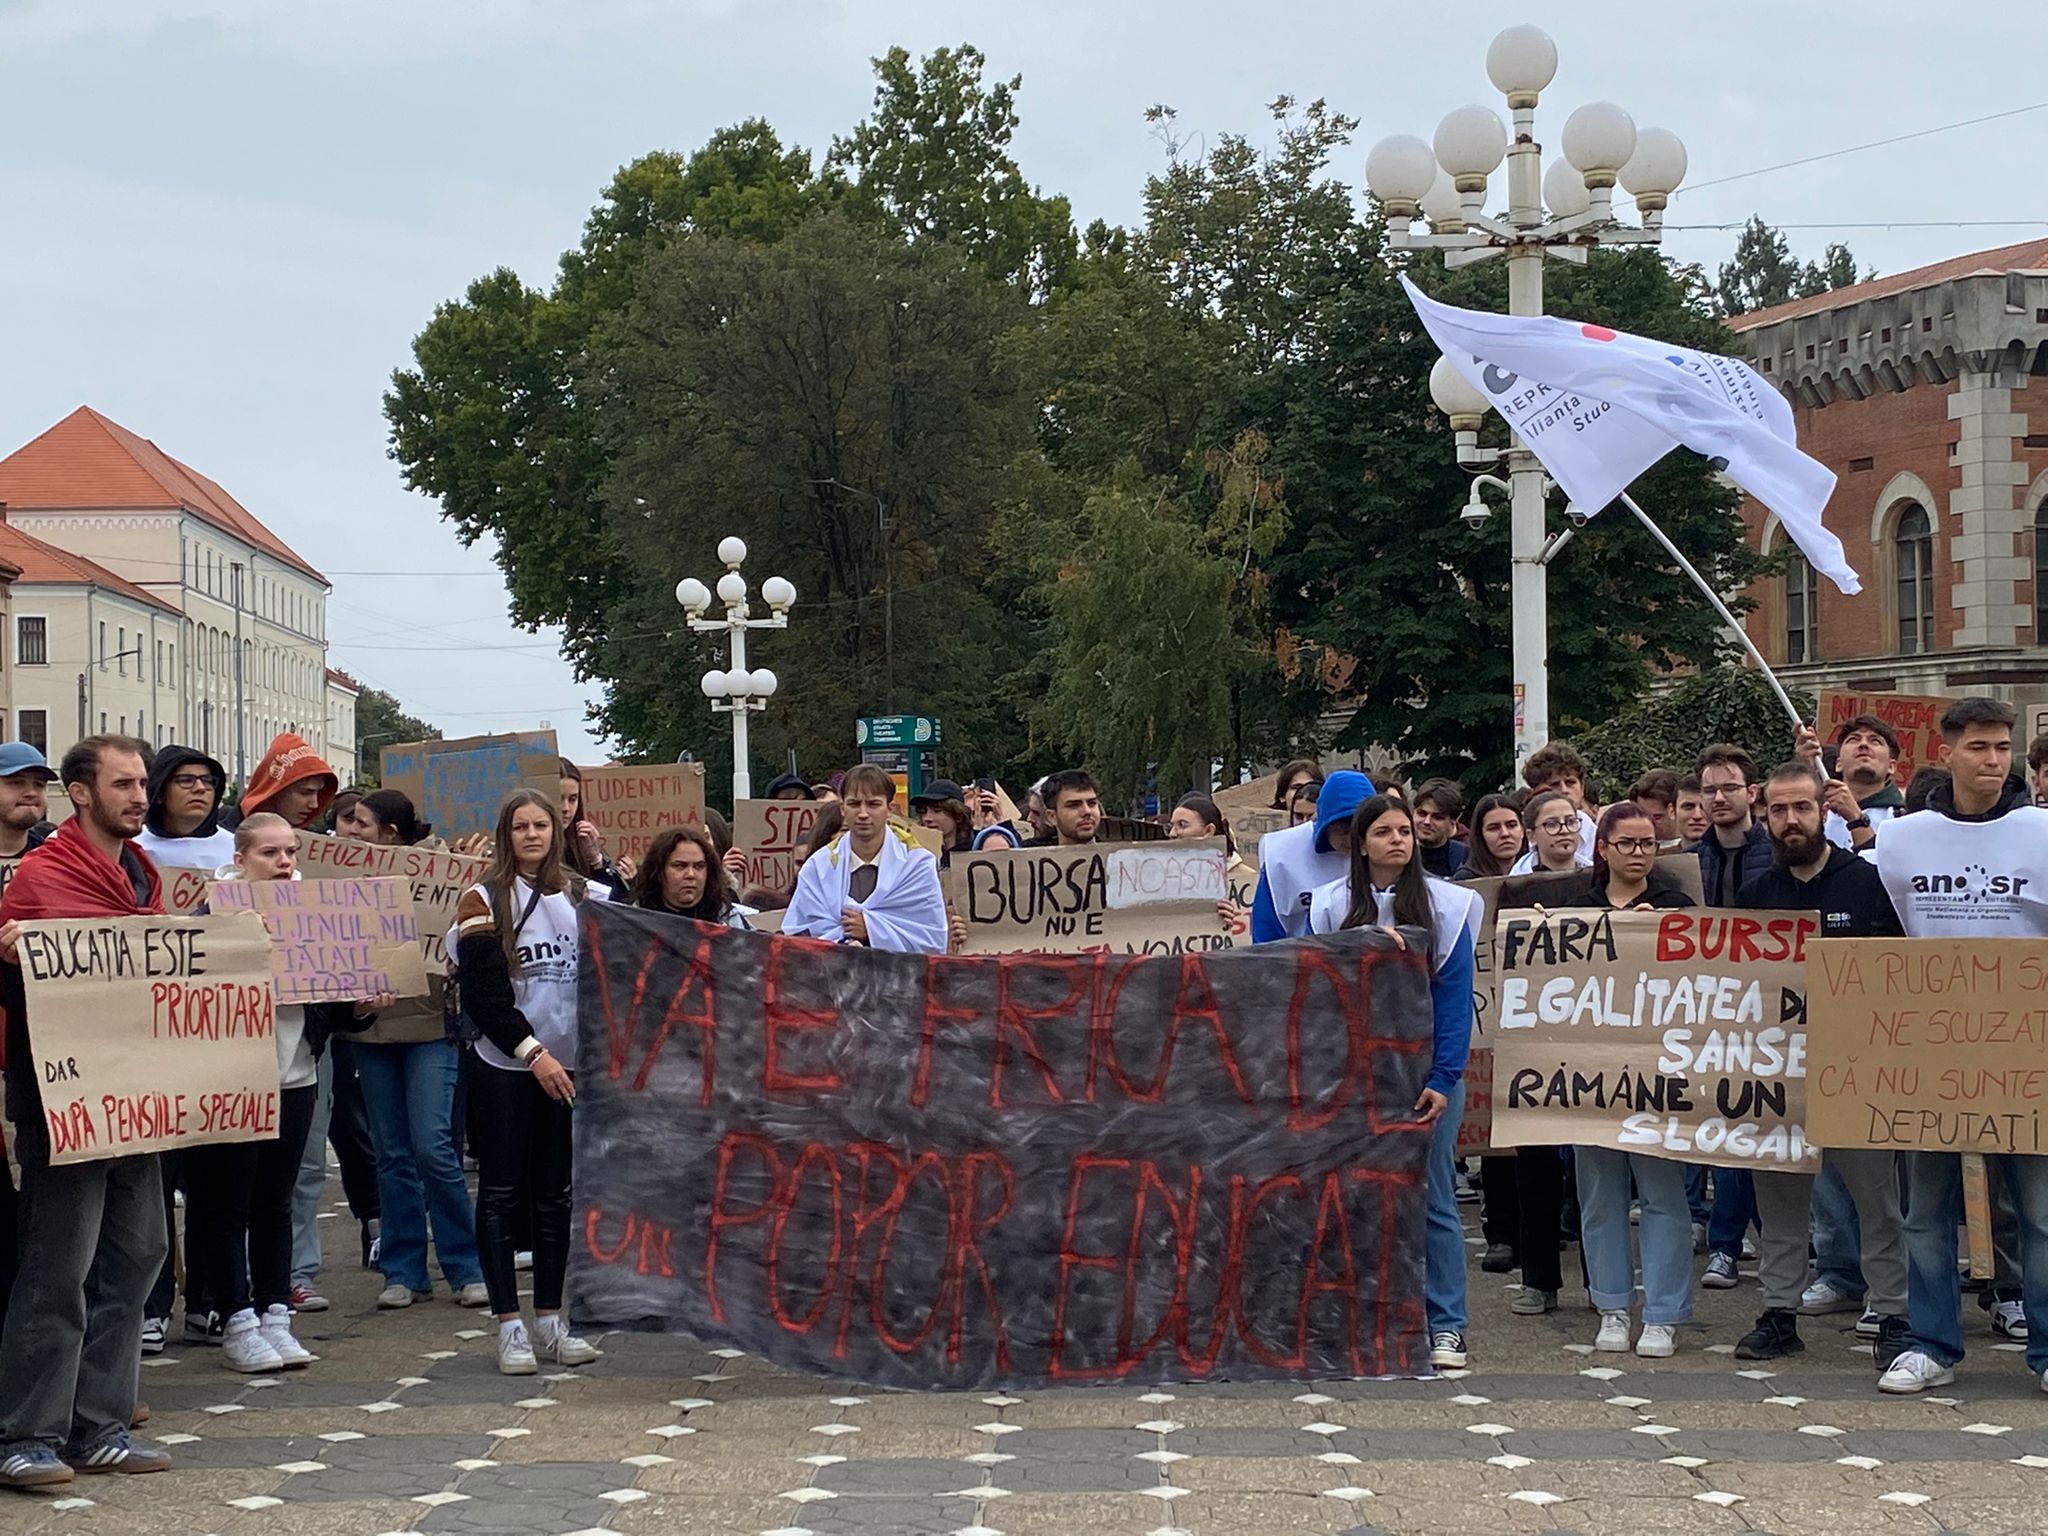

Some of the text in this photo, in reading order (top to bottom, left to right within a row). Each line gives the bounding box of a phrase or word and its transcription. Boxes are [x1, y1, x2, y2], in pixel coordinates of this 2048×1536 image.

[617, 811, 650, 829] CER
[761, 806, 819, 845] STA
[967, 854, 1107, 924] BURSA
[1045, 912, 1103, 937] NU E
[144, 928, 207, 977] ESTE
[1821, 943, 1865, 996] VĂ
[1875, 944, 2001, 996] RUGĂM
[1500, 971, 1763, 1029] EGALITATEA
[762, 935, 843, 1091] E
[1286, 944, 1432, 1136] DE
[1869, 1010, 1920, 1047] NE
[45, 1057, 80, 1083] DAR
[1819, 1056, 1858, 1098] CĂ
[1876, 1066, 1919, 1096] NU
[48, 1096, 97, 1154] DUPĂ
[198, 1086, 275, 1133] SPECIALE
[1717, 1078, 1786, 1119] UN
[586, 1208, 674, 1277] UN
[704, 1132, 1019, 1373] POPOR
